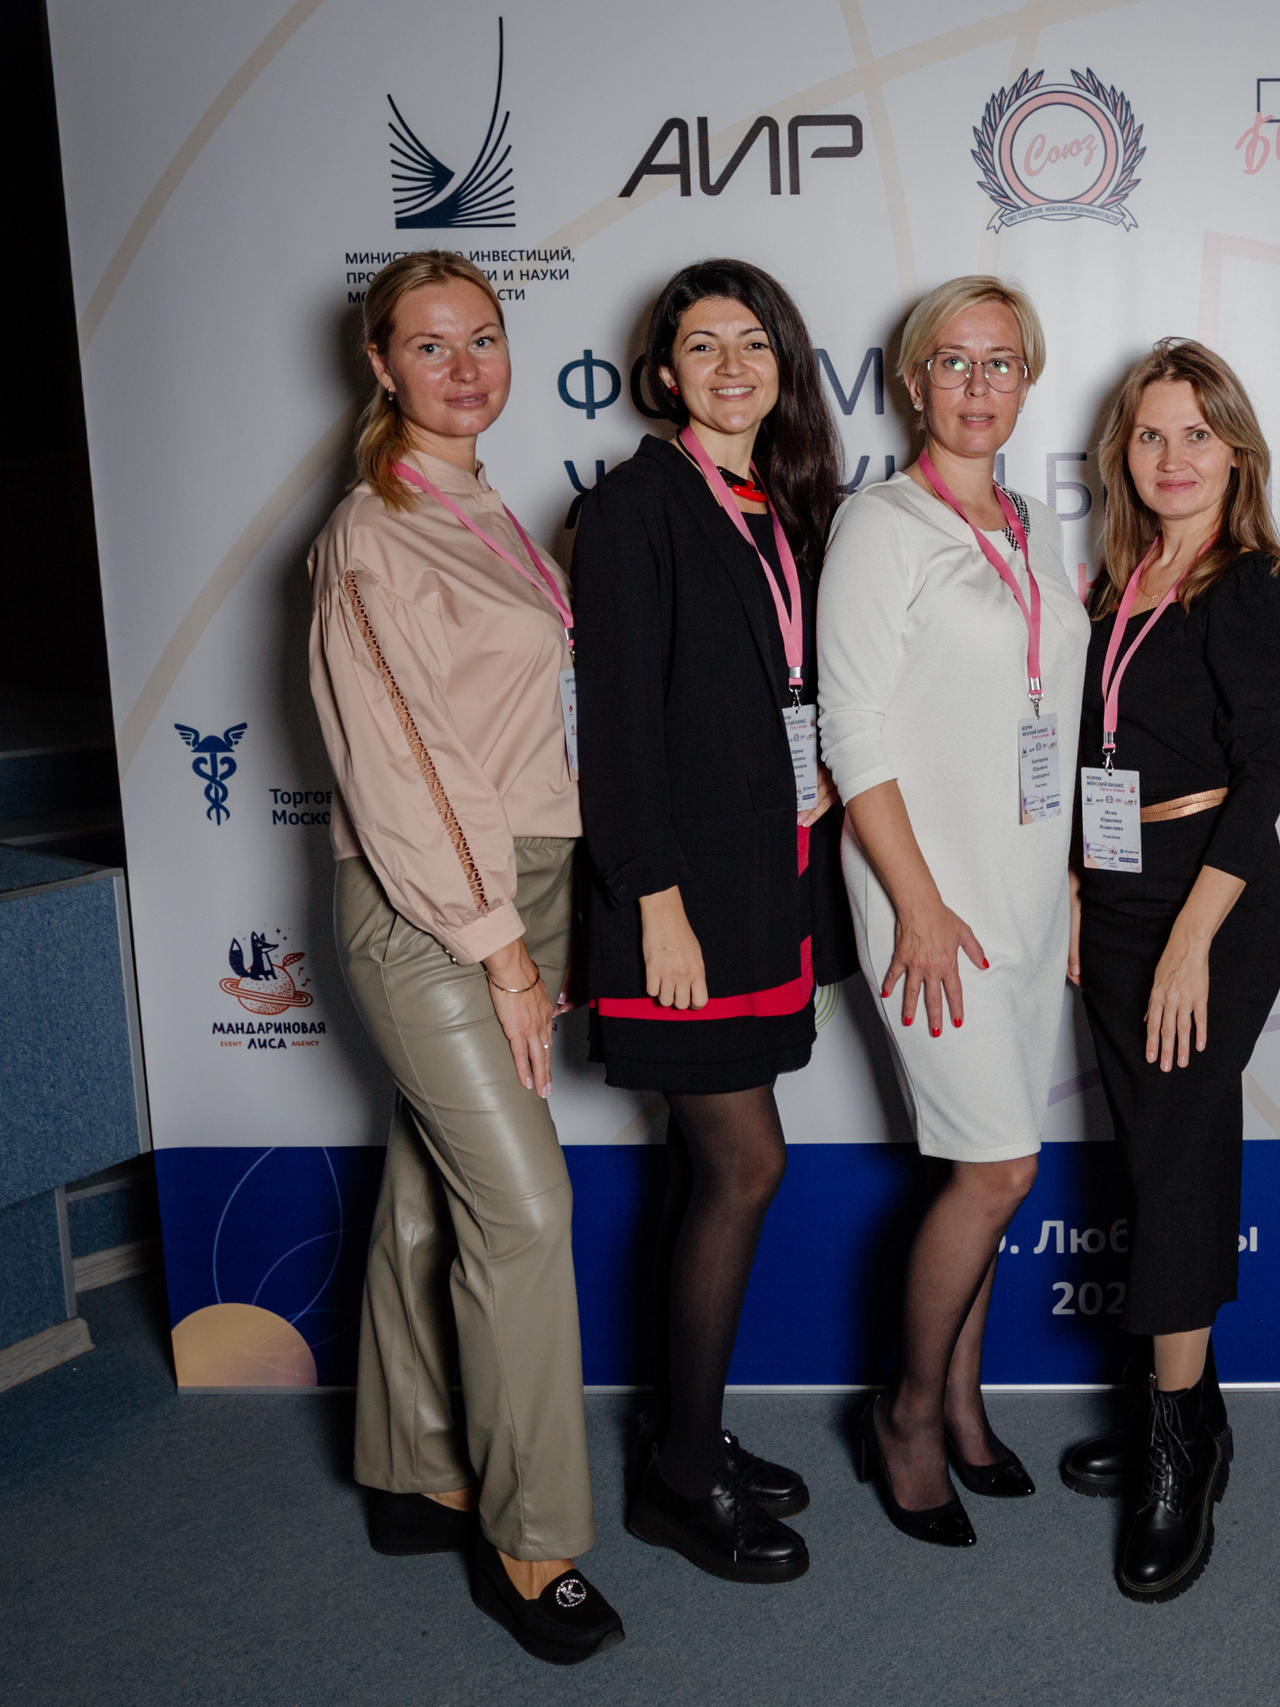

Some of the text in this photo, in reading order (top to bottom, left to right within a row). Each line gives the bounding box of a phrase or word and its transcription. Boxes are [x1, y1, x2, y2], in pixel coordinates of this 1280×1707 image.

[617, 113, 863, 198] АИР
[1023, 131, 1098, 179] Союз
[470, 246, 575, 263] ИНВЕСТИЦИЙ,
[504, 270, 514, 281] И
[520, 269, 569, 281] НАУКИ
[212, 1022, 326, 1035] МАНДАРИНОВАЯ
[247, 1038, 287, 1049] ЛИСА
